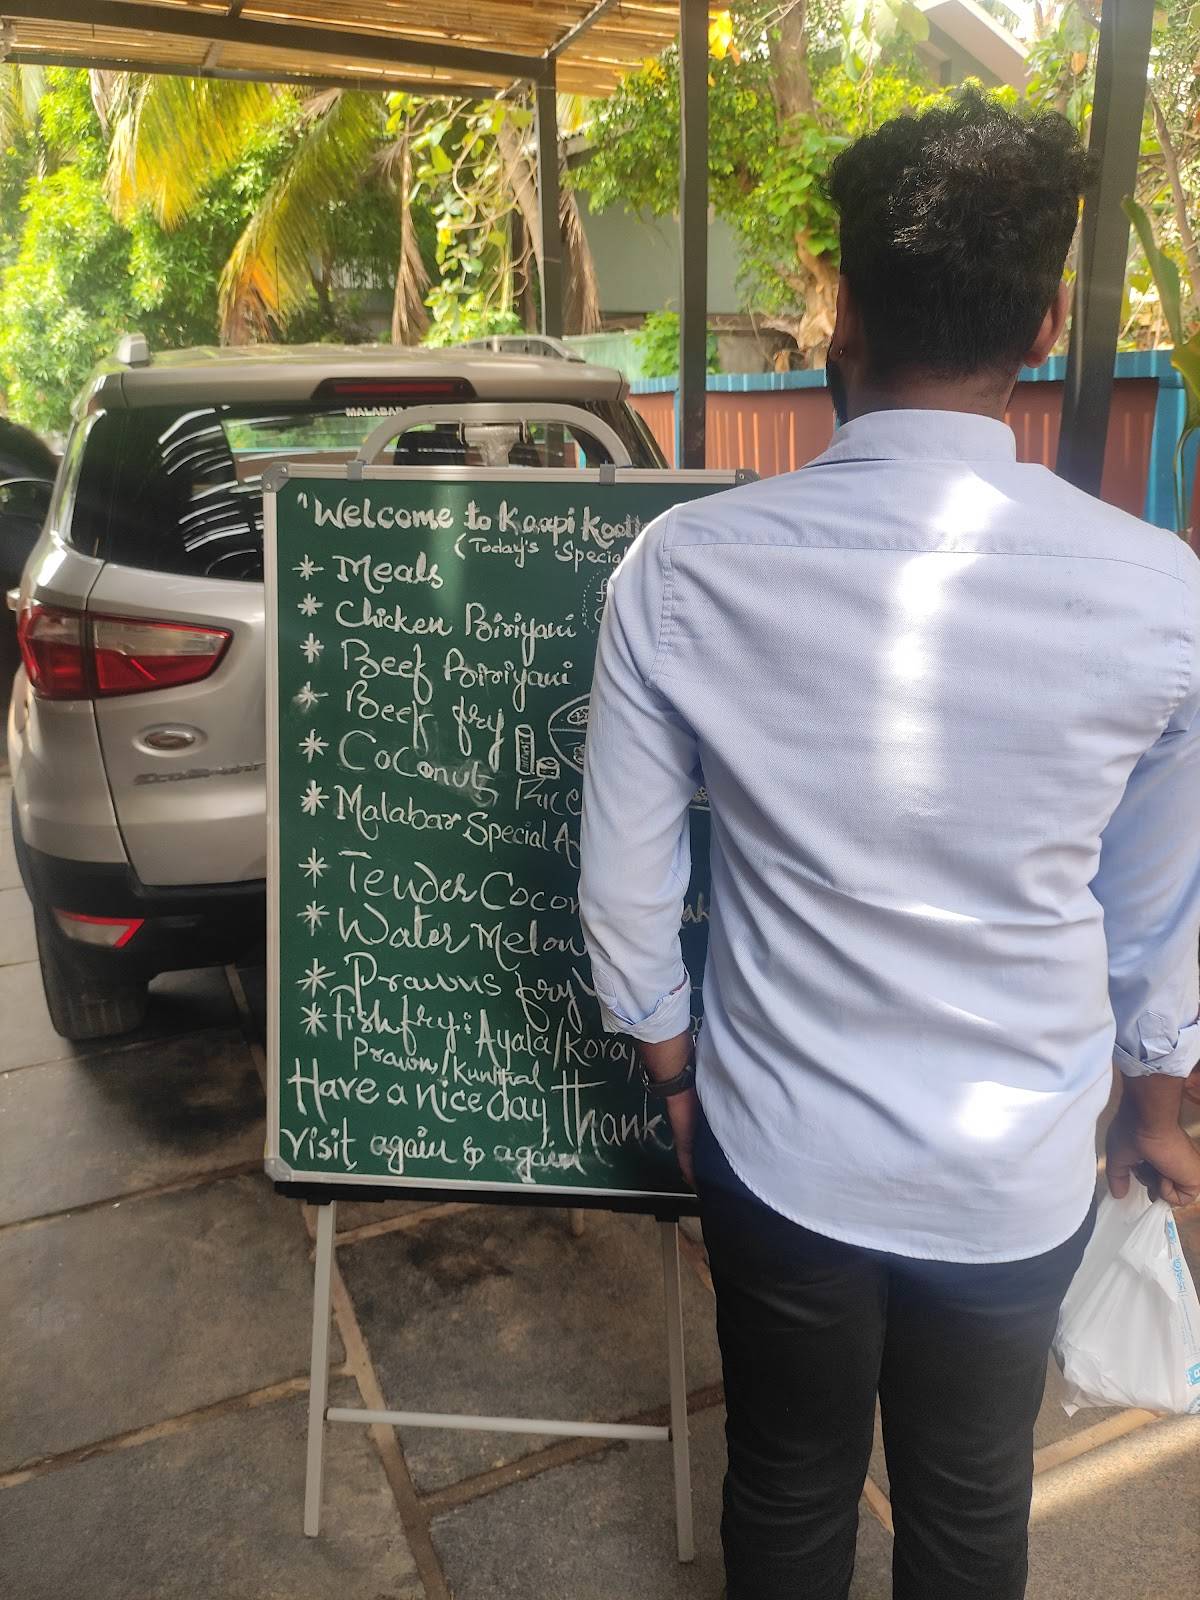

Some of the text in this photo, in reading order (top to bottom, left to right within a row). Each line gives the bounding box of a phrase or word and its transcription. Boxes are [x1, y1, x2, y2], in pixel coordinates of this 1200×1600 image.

[464, 500, 492, 531] to
[332, 552, 443, 595] Meals
[335, 598, 452, 637] Chicken
[341, 639, 433, 705] Beef
[346, 679, 435, 756] Beef
[333, 784, 460, 841] Malabar
[463, 811, 550, 854] Special
[338, 902, 470, 953] Water
[286, 1057, 380, 1124] Have
[387, 1088, 408, 1106] a
[370, 1125, 458, 1174] again
